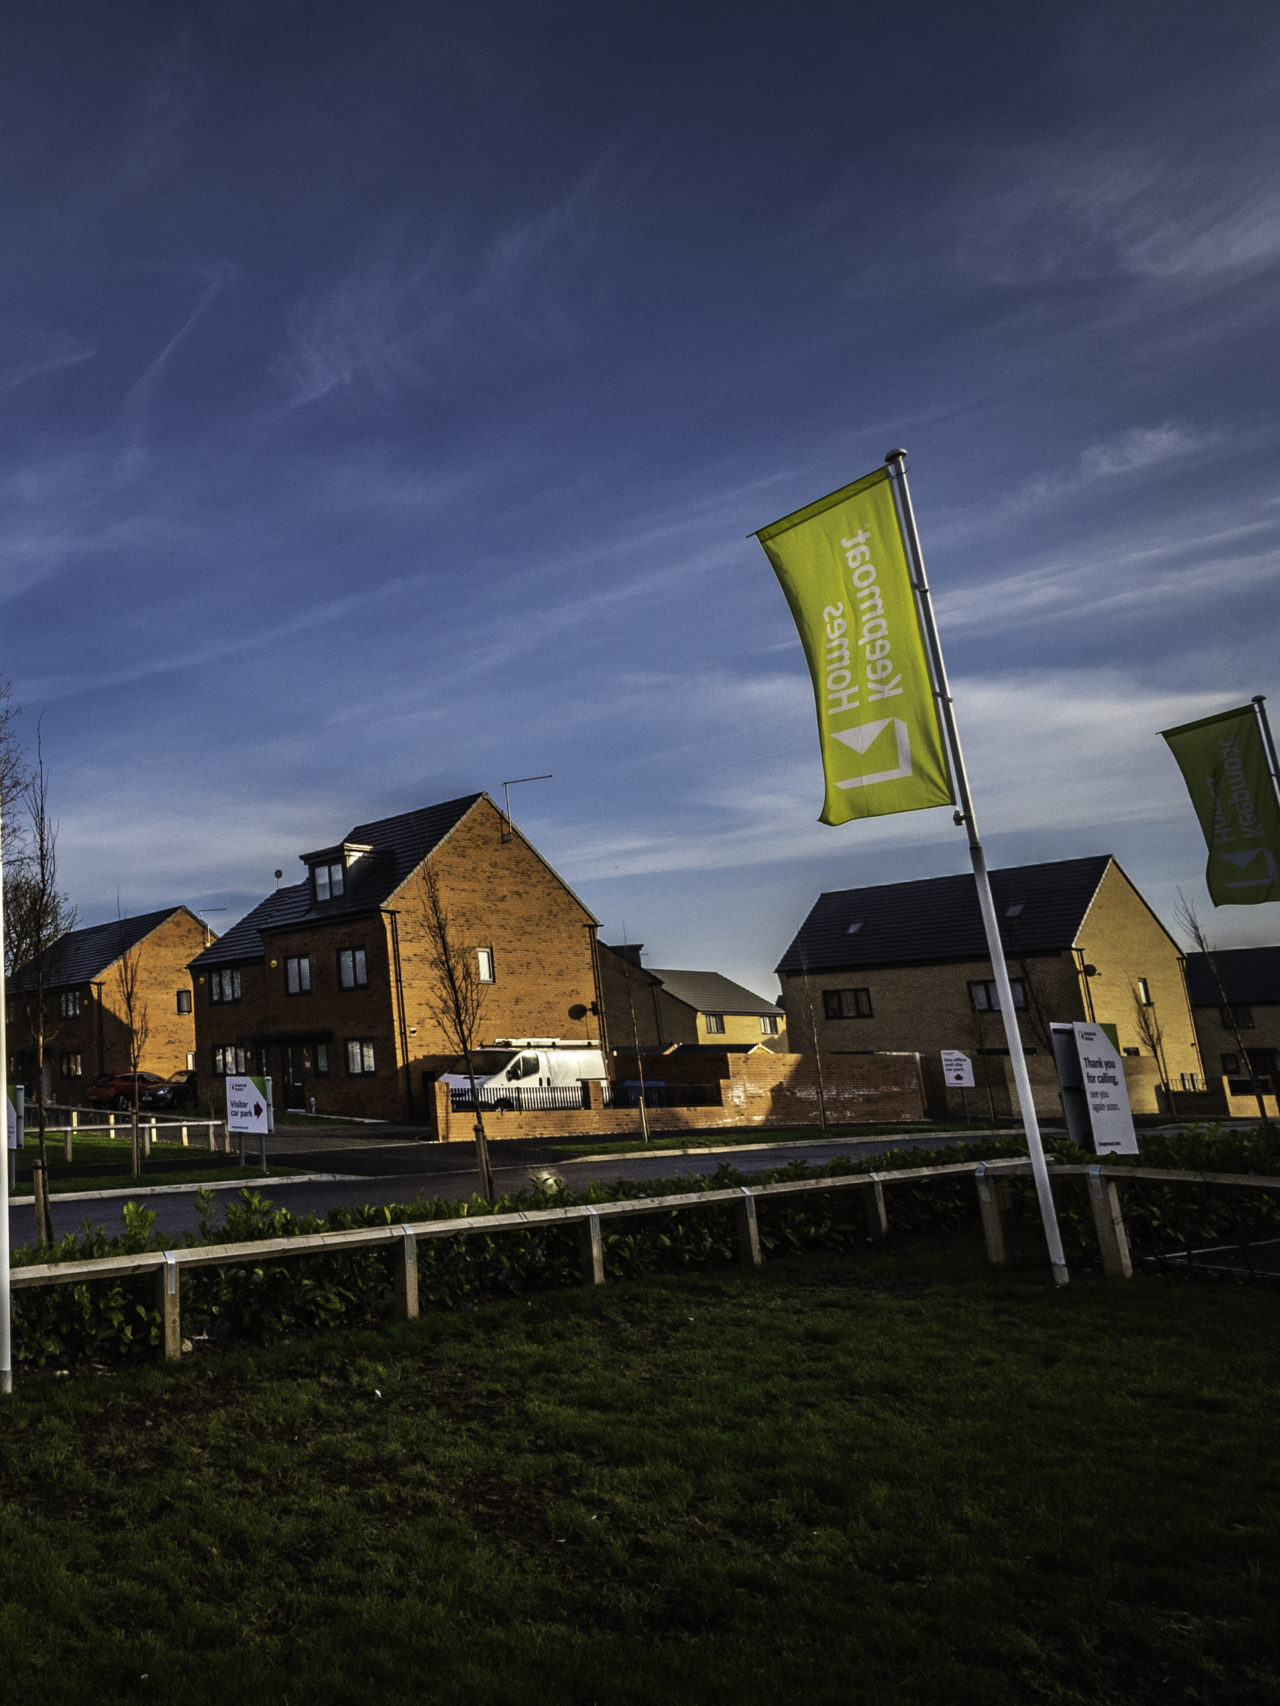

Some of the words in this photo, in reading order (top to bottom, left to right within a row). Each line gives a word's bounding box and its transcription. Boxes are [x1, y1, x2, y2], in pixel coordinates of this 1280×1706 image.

[1083, 1057, 1104, 1069] Thank
[1104, 1060, 1116, 1072] you
[1087, 1072, 1096, 1084] for
[240, 1110, 253, 1118] park
